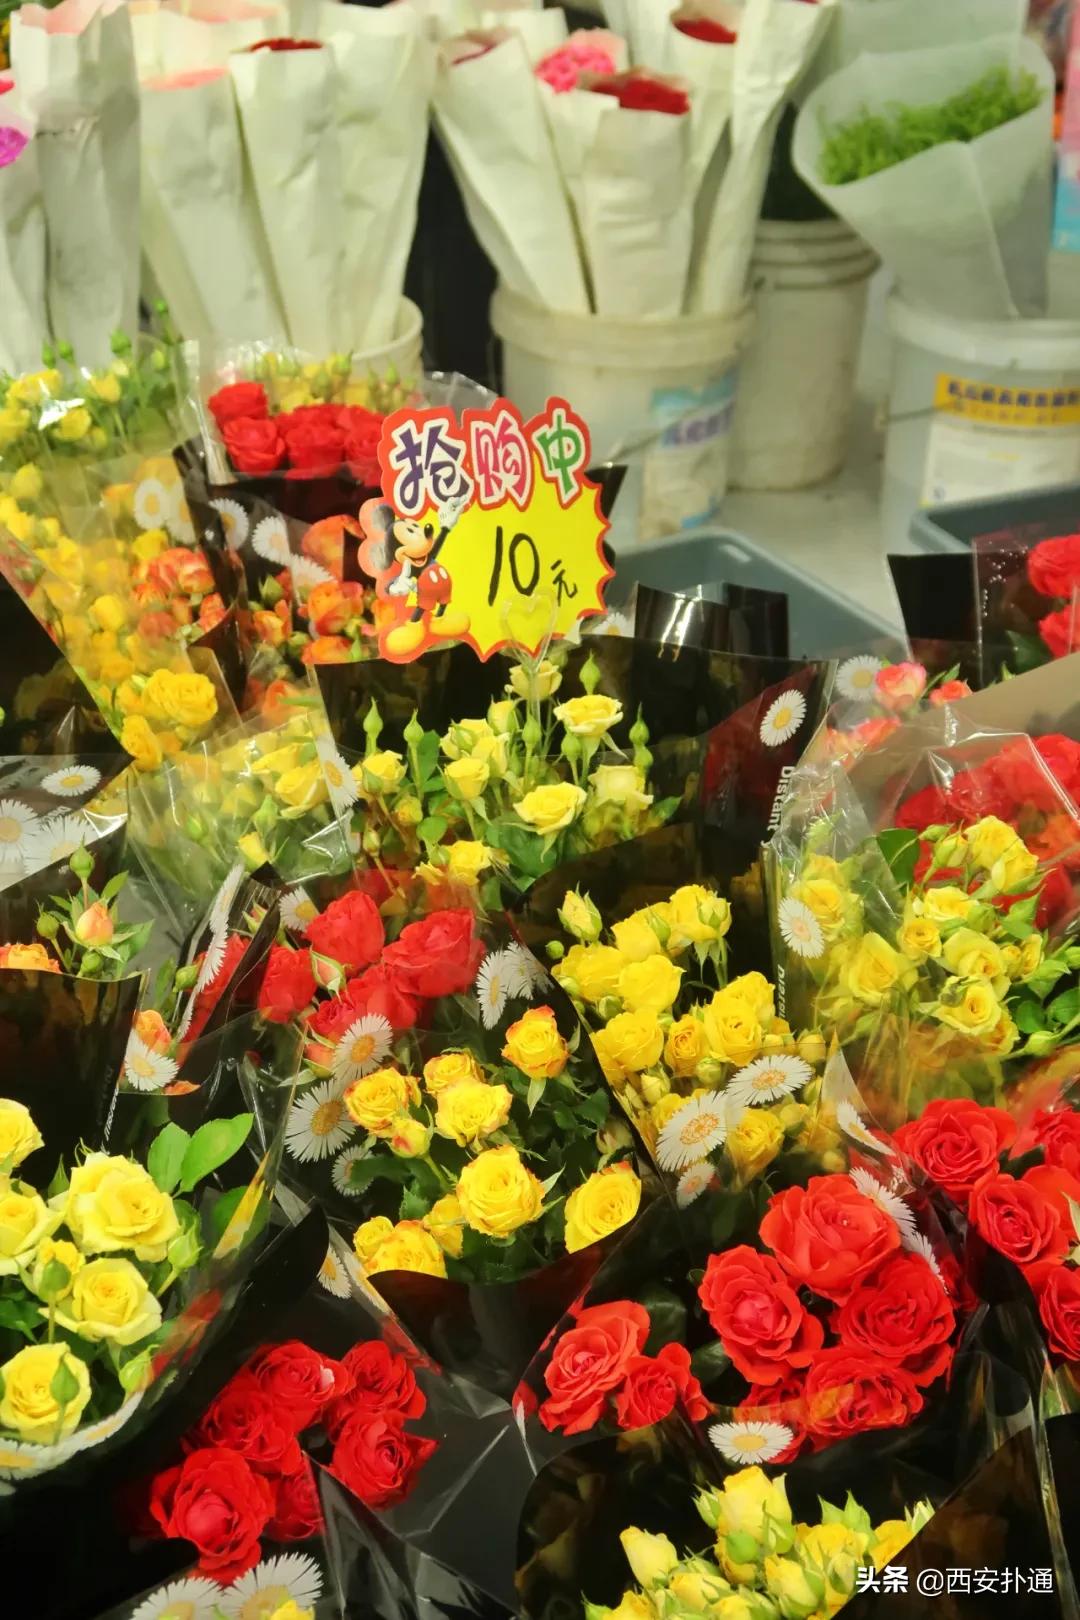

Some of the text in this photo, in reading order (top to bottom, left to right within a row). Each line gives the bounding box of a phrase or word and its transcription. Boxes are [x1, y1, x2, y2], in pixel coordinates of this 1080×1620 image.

[391, 410, 584, 512] 抢购中
[766, 765, 797, 832] Distant
